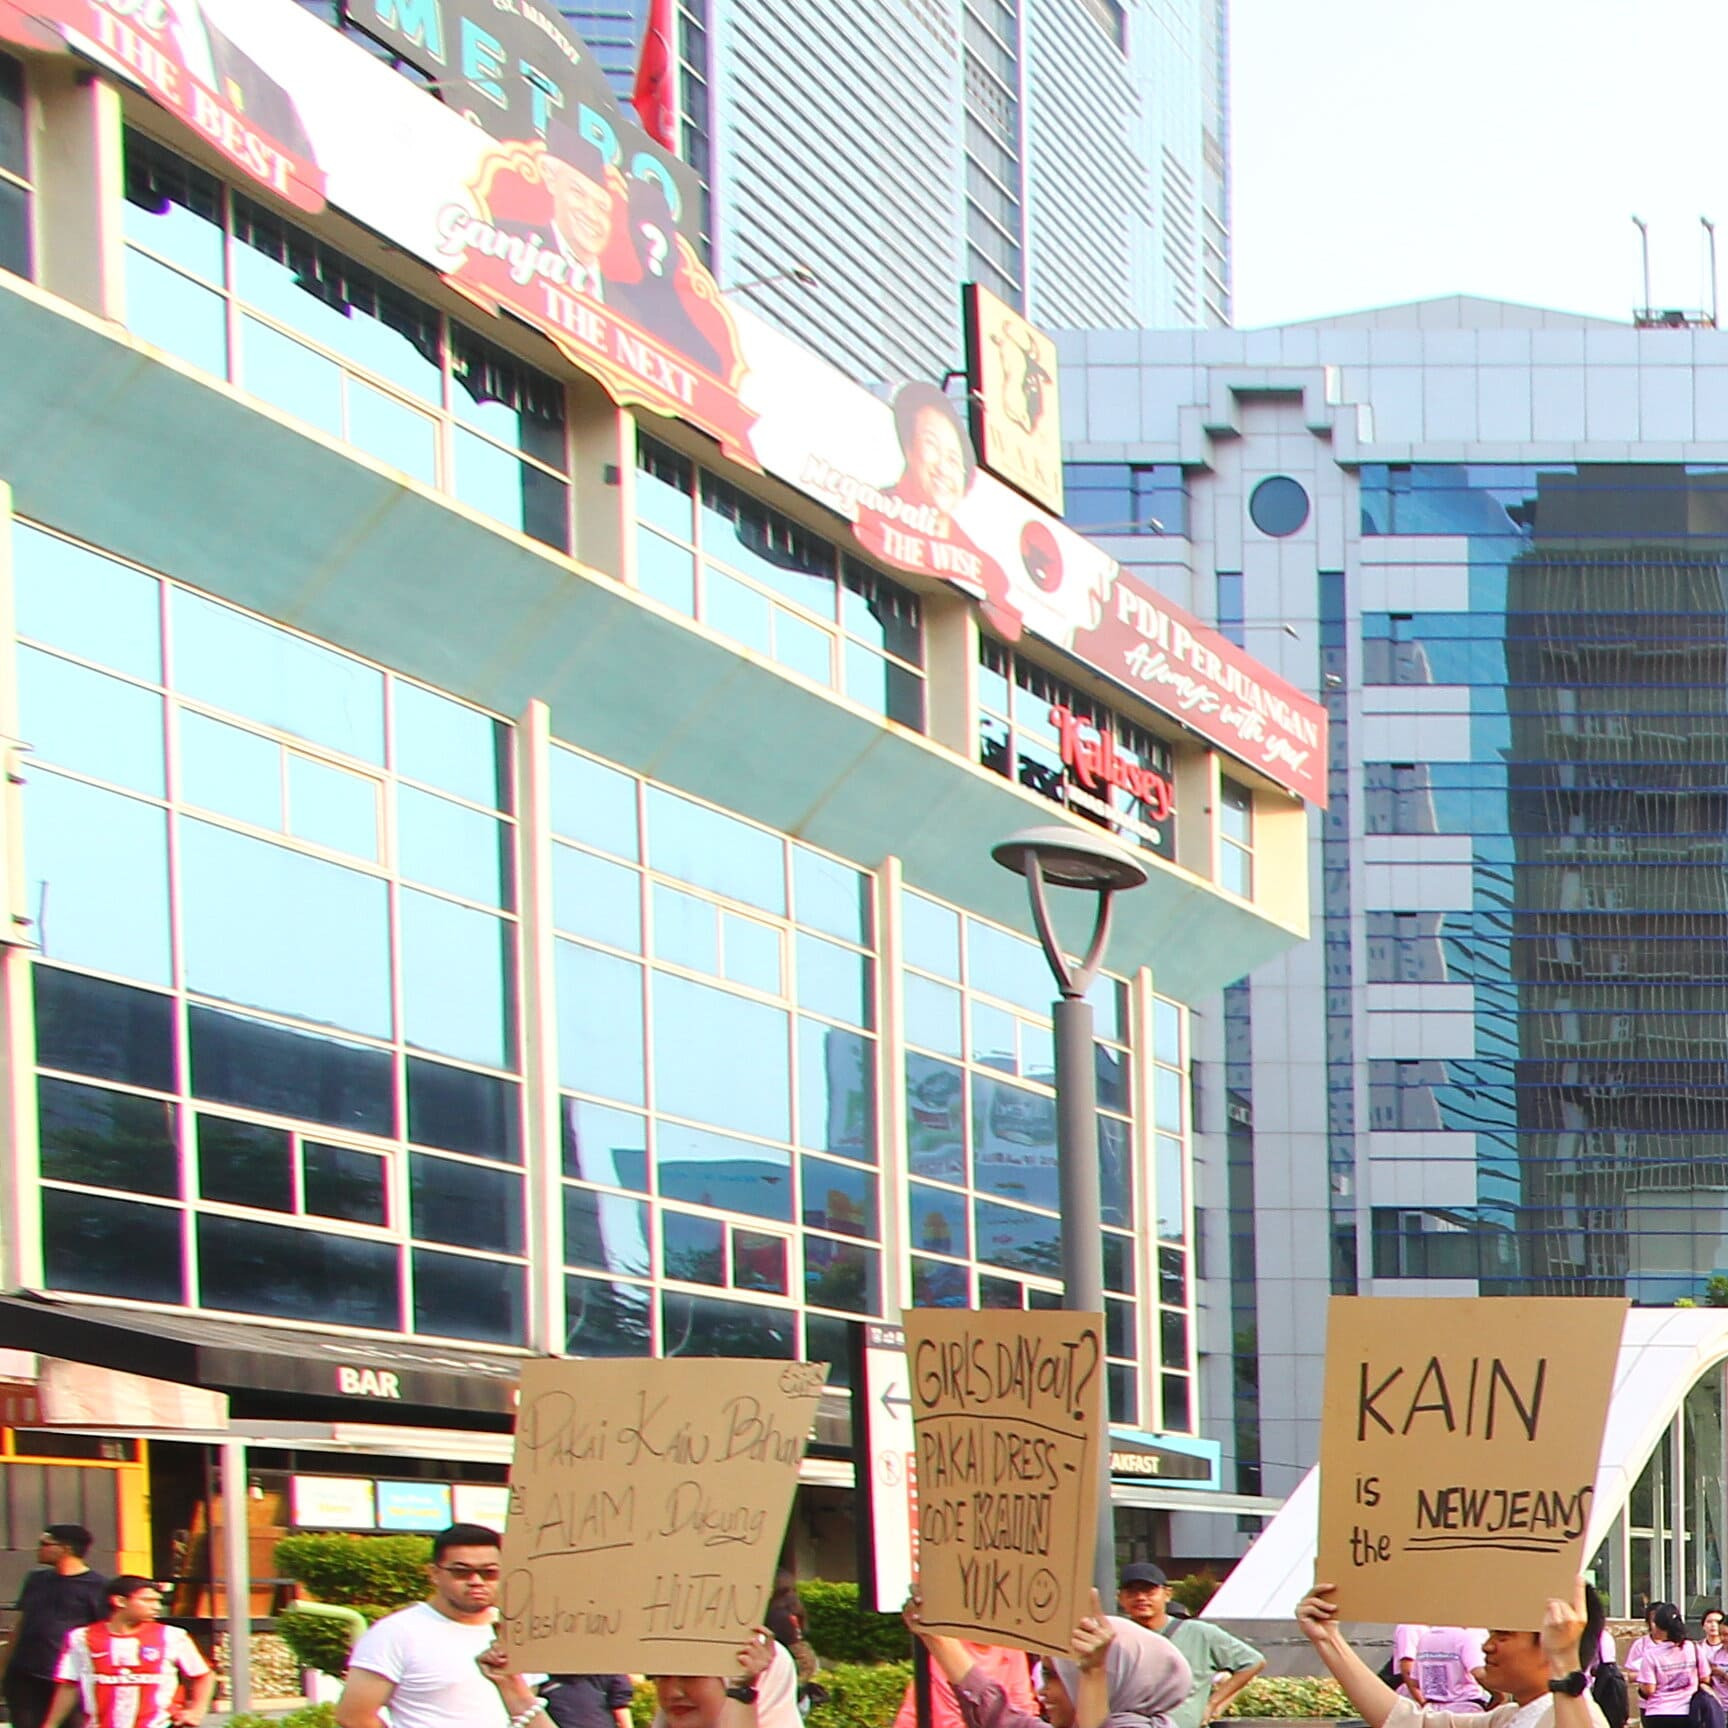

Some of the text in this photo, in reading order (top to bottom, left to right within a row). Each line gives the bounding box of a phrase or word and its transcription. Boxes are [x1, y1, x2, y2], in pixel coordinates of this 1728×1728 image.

[92, 4, 296, 196] THE BEST
[539, 279, 699, 407] THE NEXT
[878, 519, 984, 585] THE WISE
[1114, 580, 1171, 651] PDI
[336, 1365, 401, 1399] BAR
[915, 1331, 994, 1409] GIRLS
[995, 1334, 1042, 1409] DAY
[1356, 1356, 1547, 1441] KAIN
[922, 1420, 986, 1490] PAKAI
[1110, 1452, 1161, 1474] AKFAST
[922, 1491, 1051, 1556] CODE KAIN
[1355, 1475, 1382, 1507] is
[1348, 1526, 1393, 1567] the
